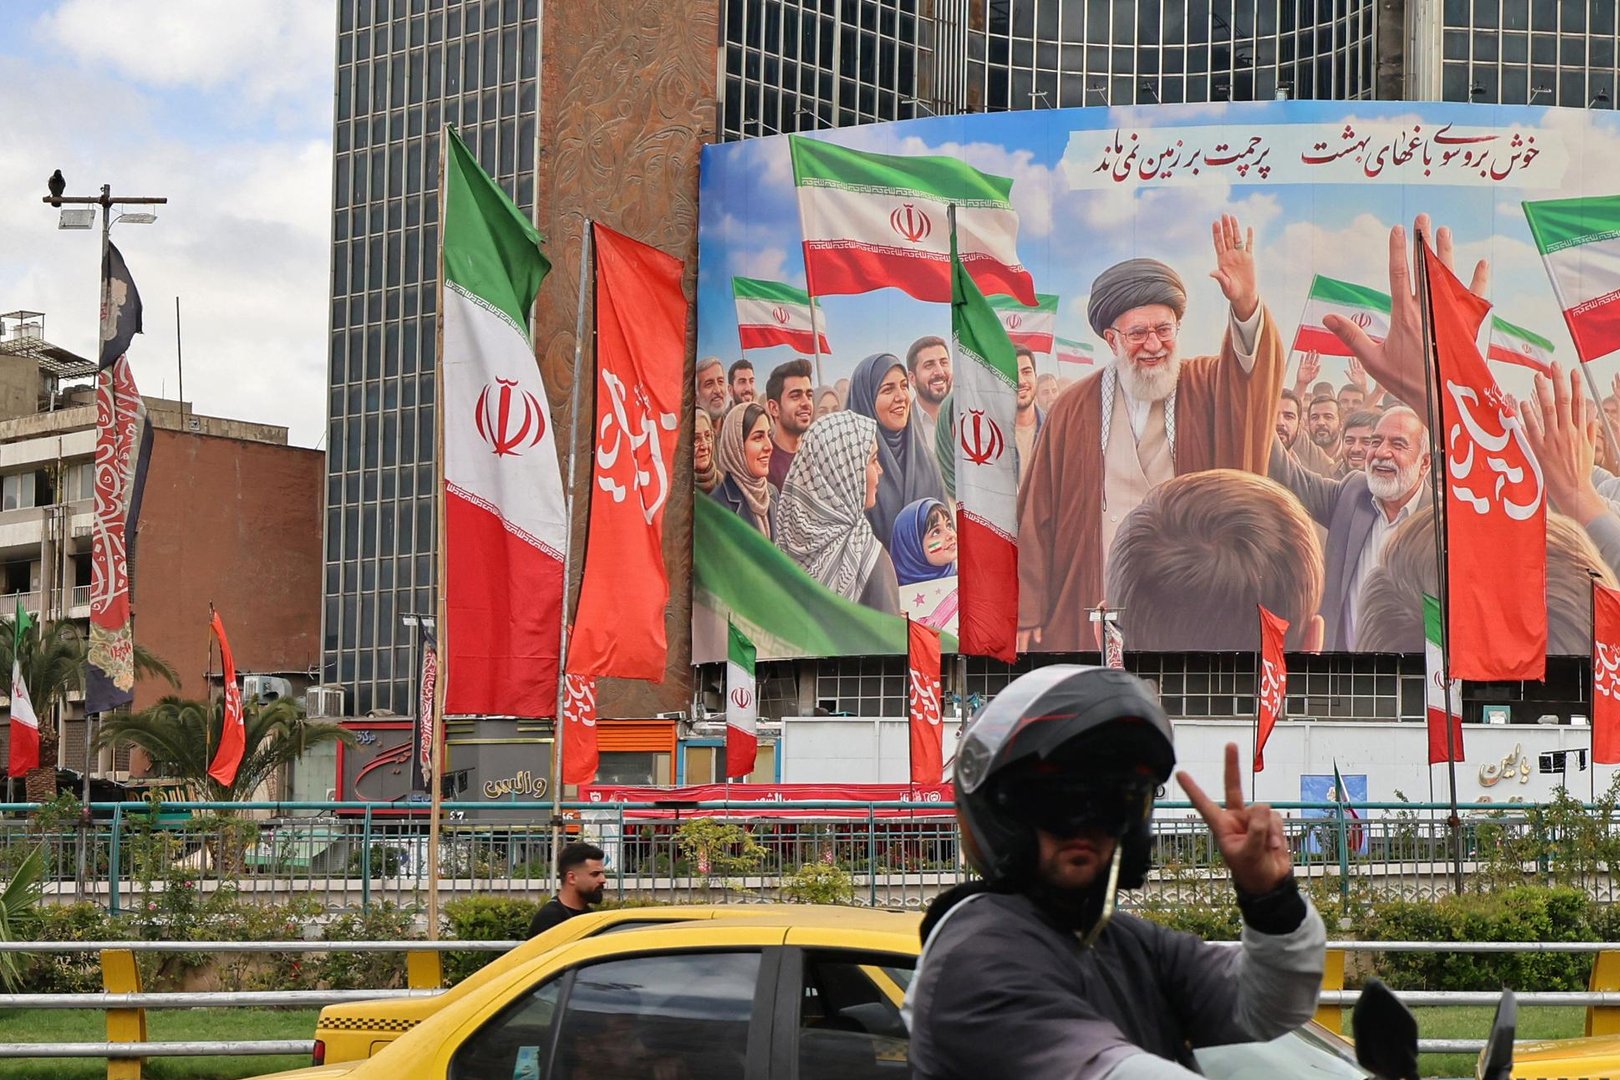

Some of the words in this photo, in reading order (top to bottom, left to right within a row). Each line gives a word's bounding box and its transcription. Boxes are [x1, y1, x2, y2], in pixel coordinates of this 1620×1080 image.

[1139, 139, 1183, 181] زمین
[1183, 147, 1201, 175] بر
[1204, 136, 1271, 180] پرچمت
[1301, 124, 1371, 165] بهشت
[1433, 122, 1500, 167] سوی
[1460, 148, 1489, 178] برو
[1490, 133, 1540, 181] خوش
[1479, 743, 1532, 788] بالین
